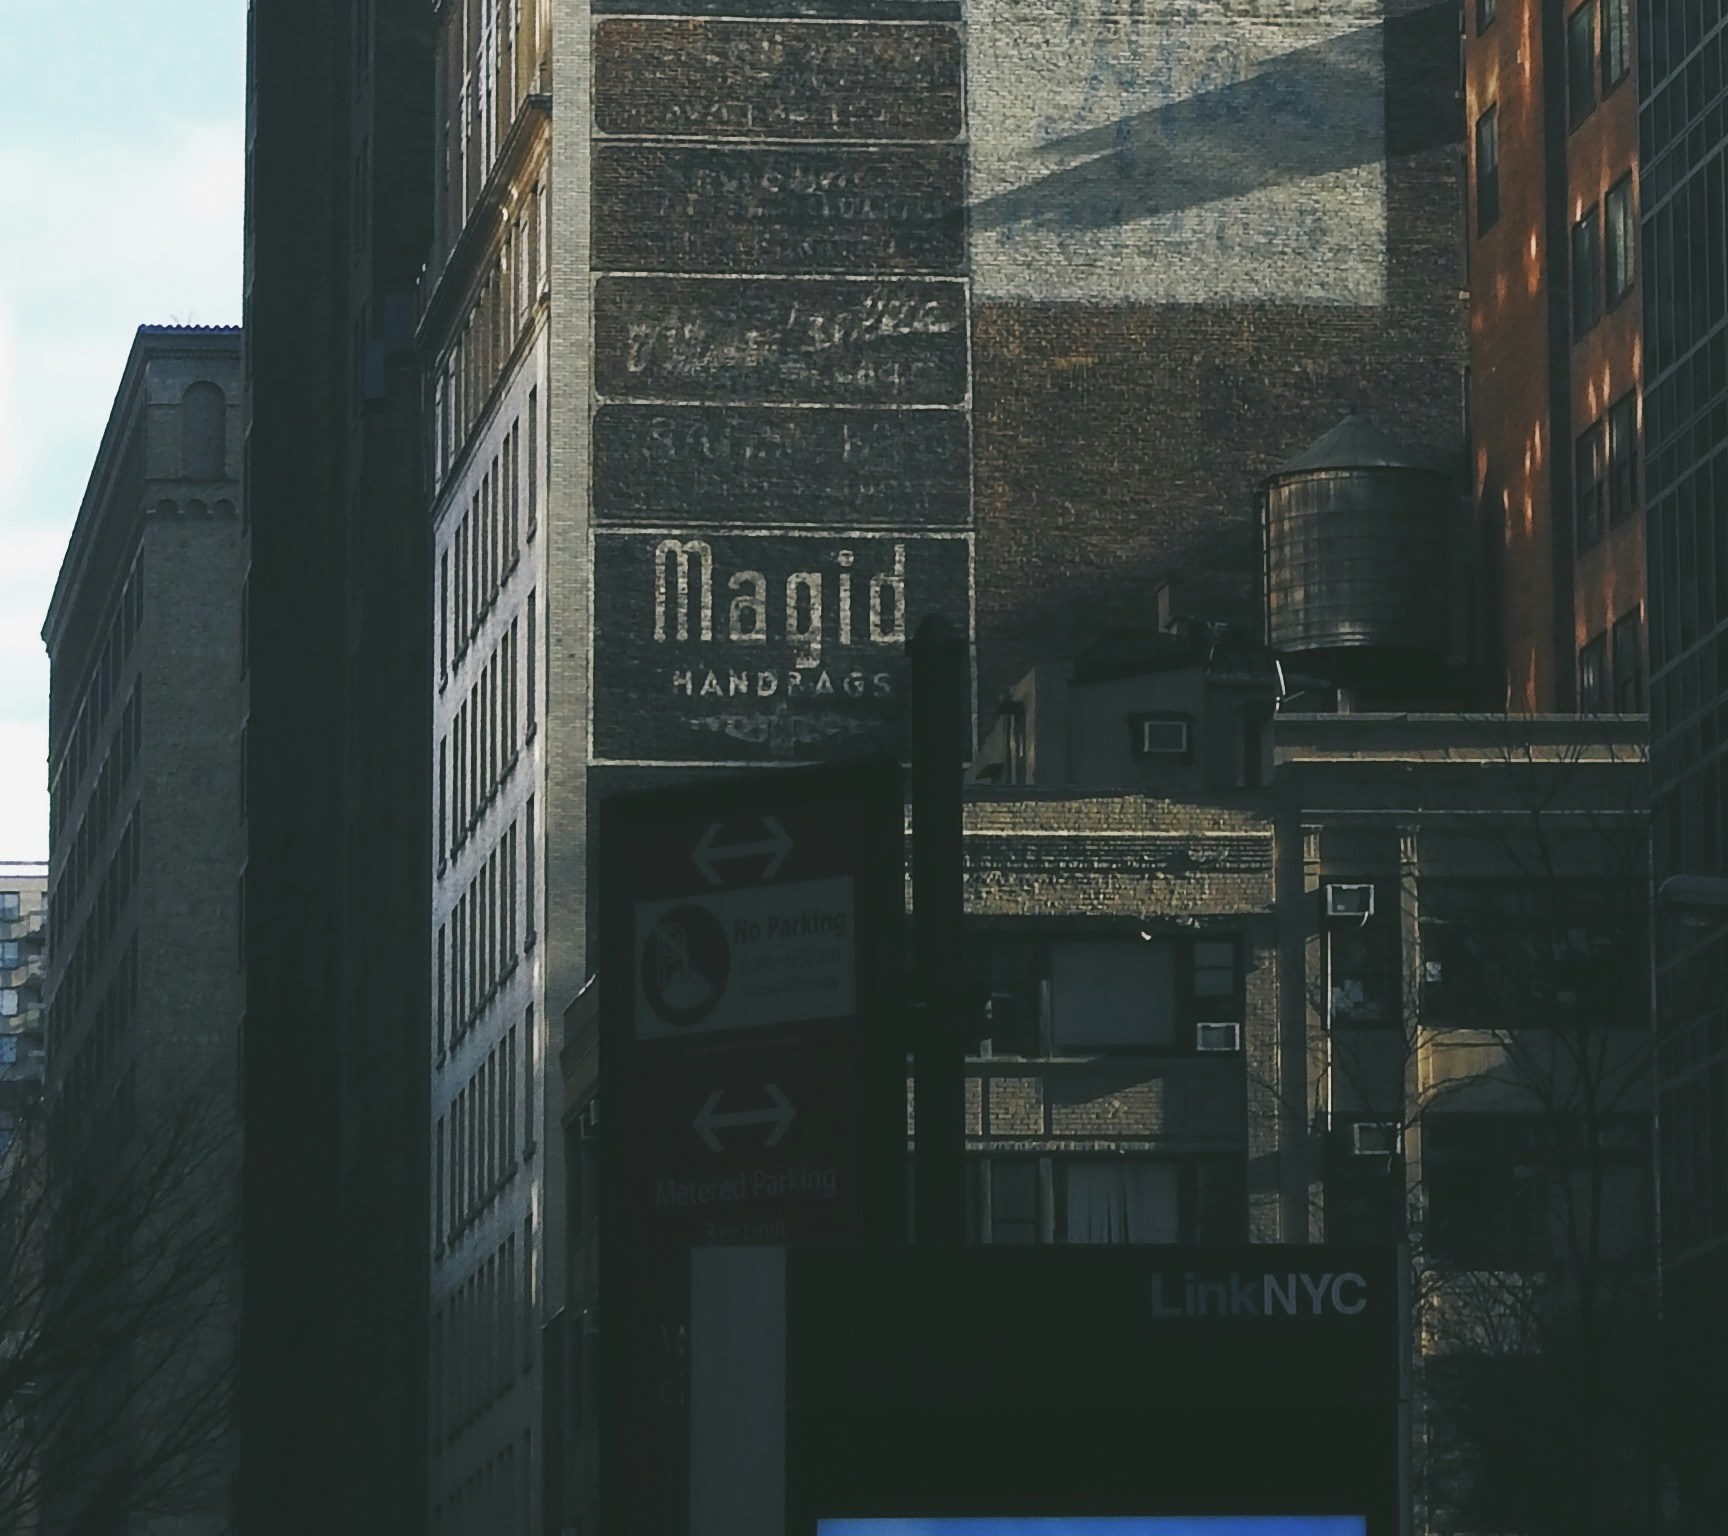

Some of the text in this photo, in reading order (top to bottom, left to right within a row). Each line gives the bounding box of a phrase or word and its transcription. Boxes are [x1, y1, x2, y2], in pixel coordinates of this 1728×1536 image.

[672, 670, 893, 697] HANDBAGS
[734, 908, 847, 943] No Parking
[655, 1166, 837, 1208] Metered Parking
[743, 1220, 787, 1241] Limit
[1151, 1272, 1367, 1317] LinkNYC
